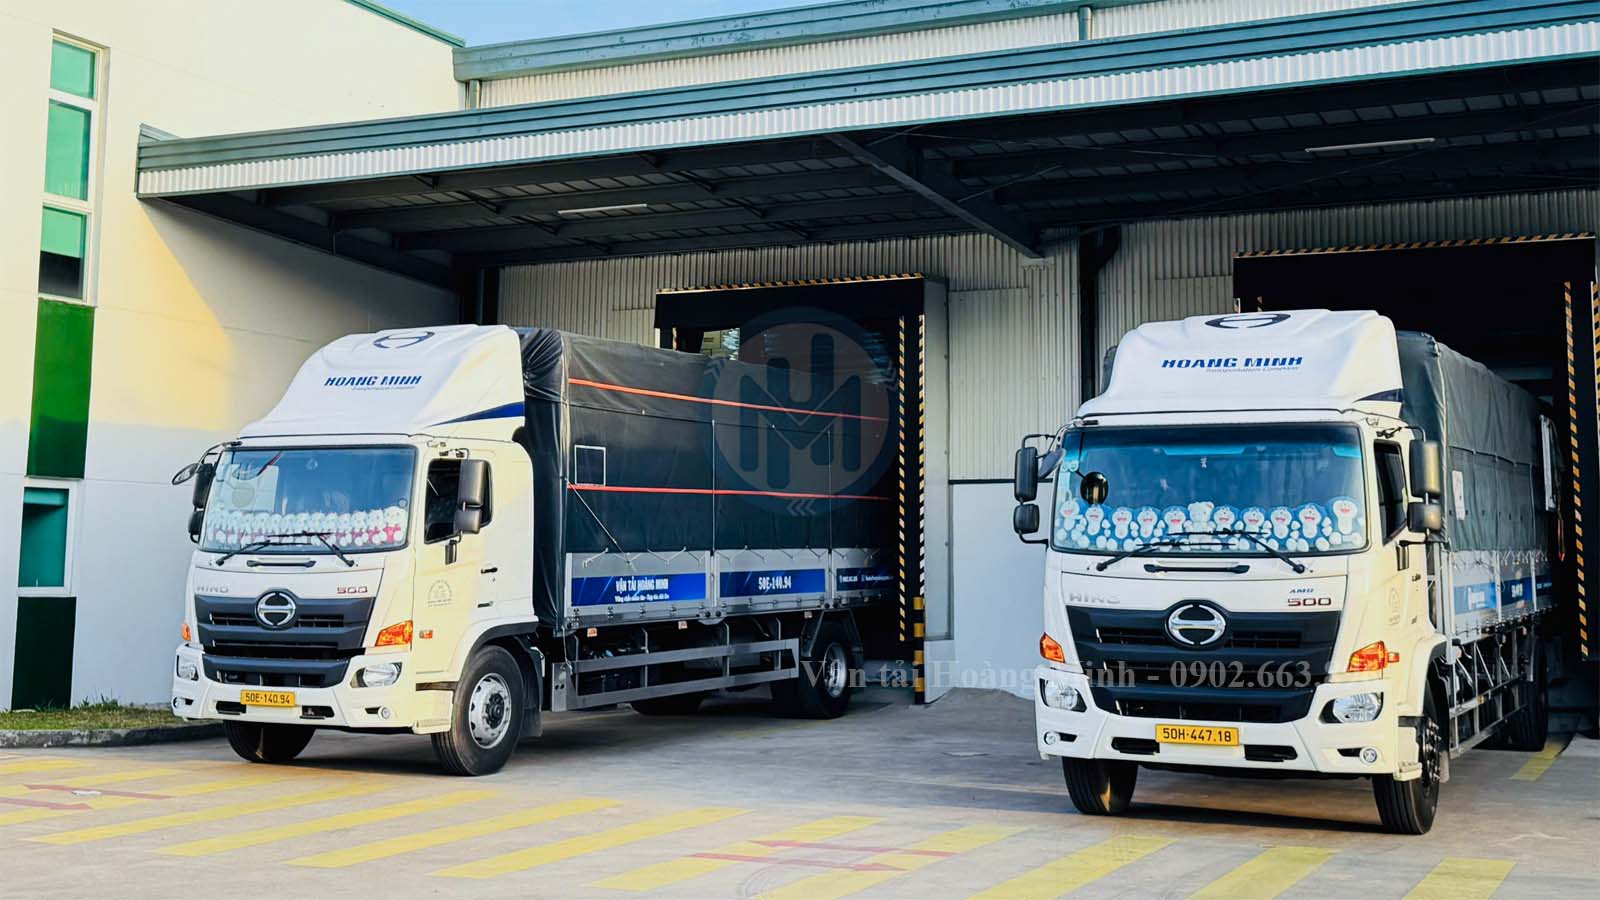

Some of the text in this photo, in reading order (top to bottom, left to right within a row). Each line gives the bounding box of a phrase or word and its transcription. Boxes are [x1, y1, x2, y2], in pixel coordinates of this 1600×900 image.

[1161, 356, 1303, 368] HOANG MINH
[324, 375, 422, 386] HOANG MINH
[758, 575, 792, 591] 50E-140.94
[196, 585, 229, 594] HINO
[336, 585, 368, 594] 500
[1287, 597, 1332, 606] 500
[244, 691, 292, 705] 50E-140.94
[1162, 727, 1233, 743] 50H-447.18
